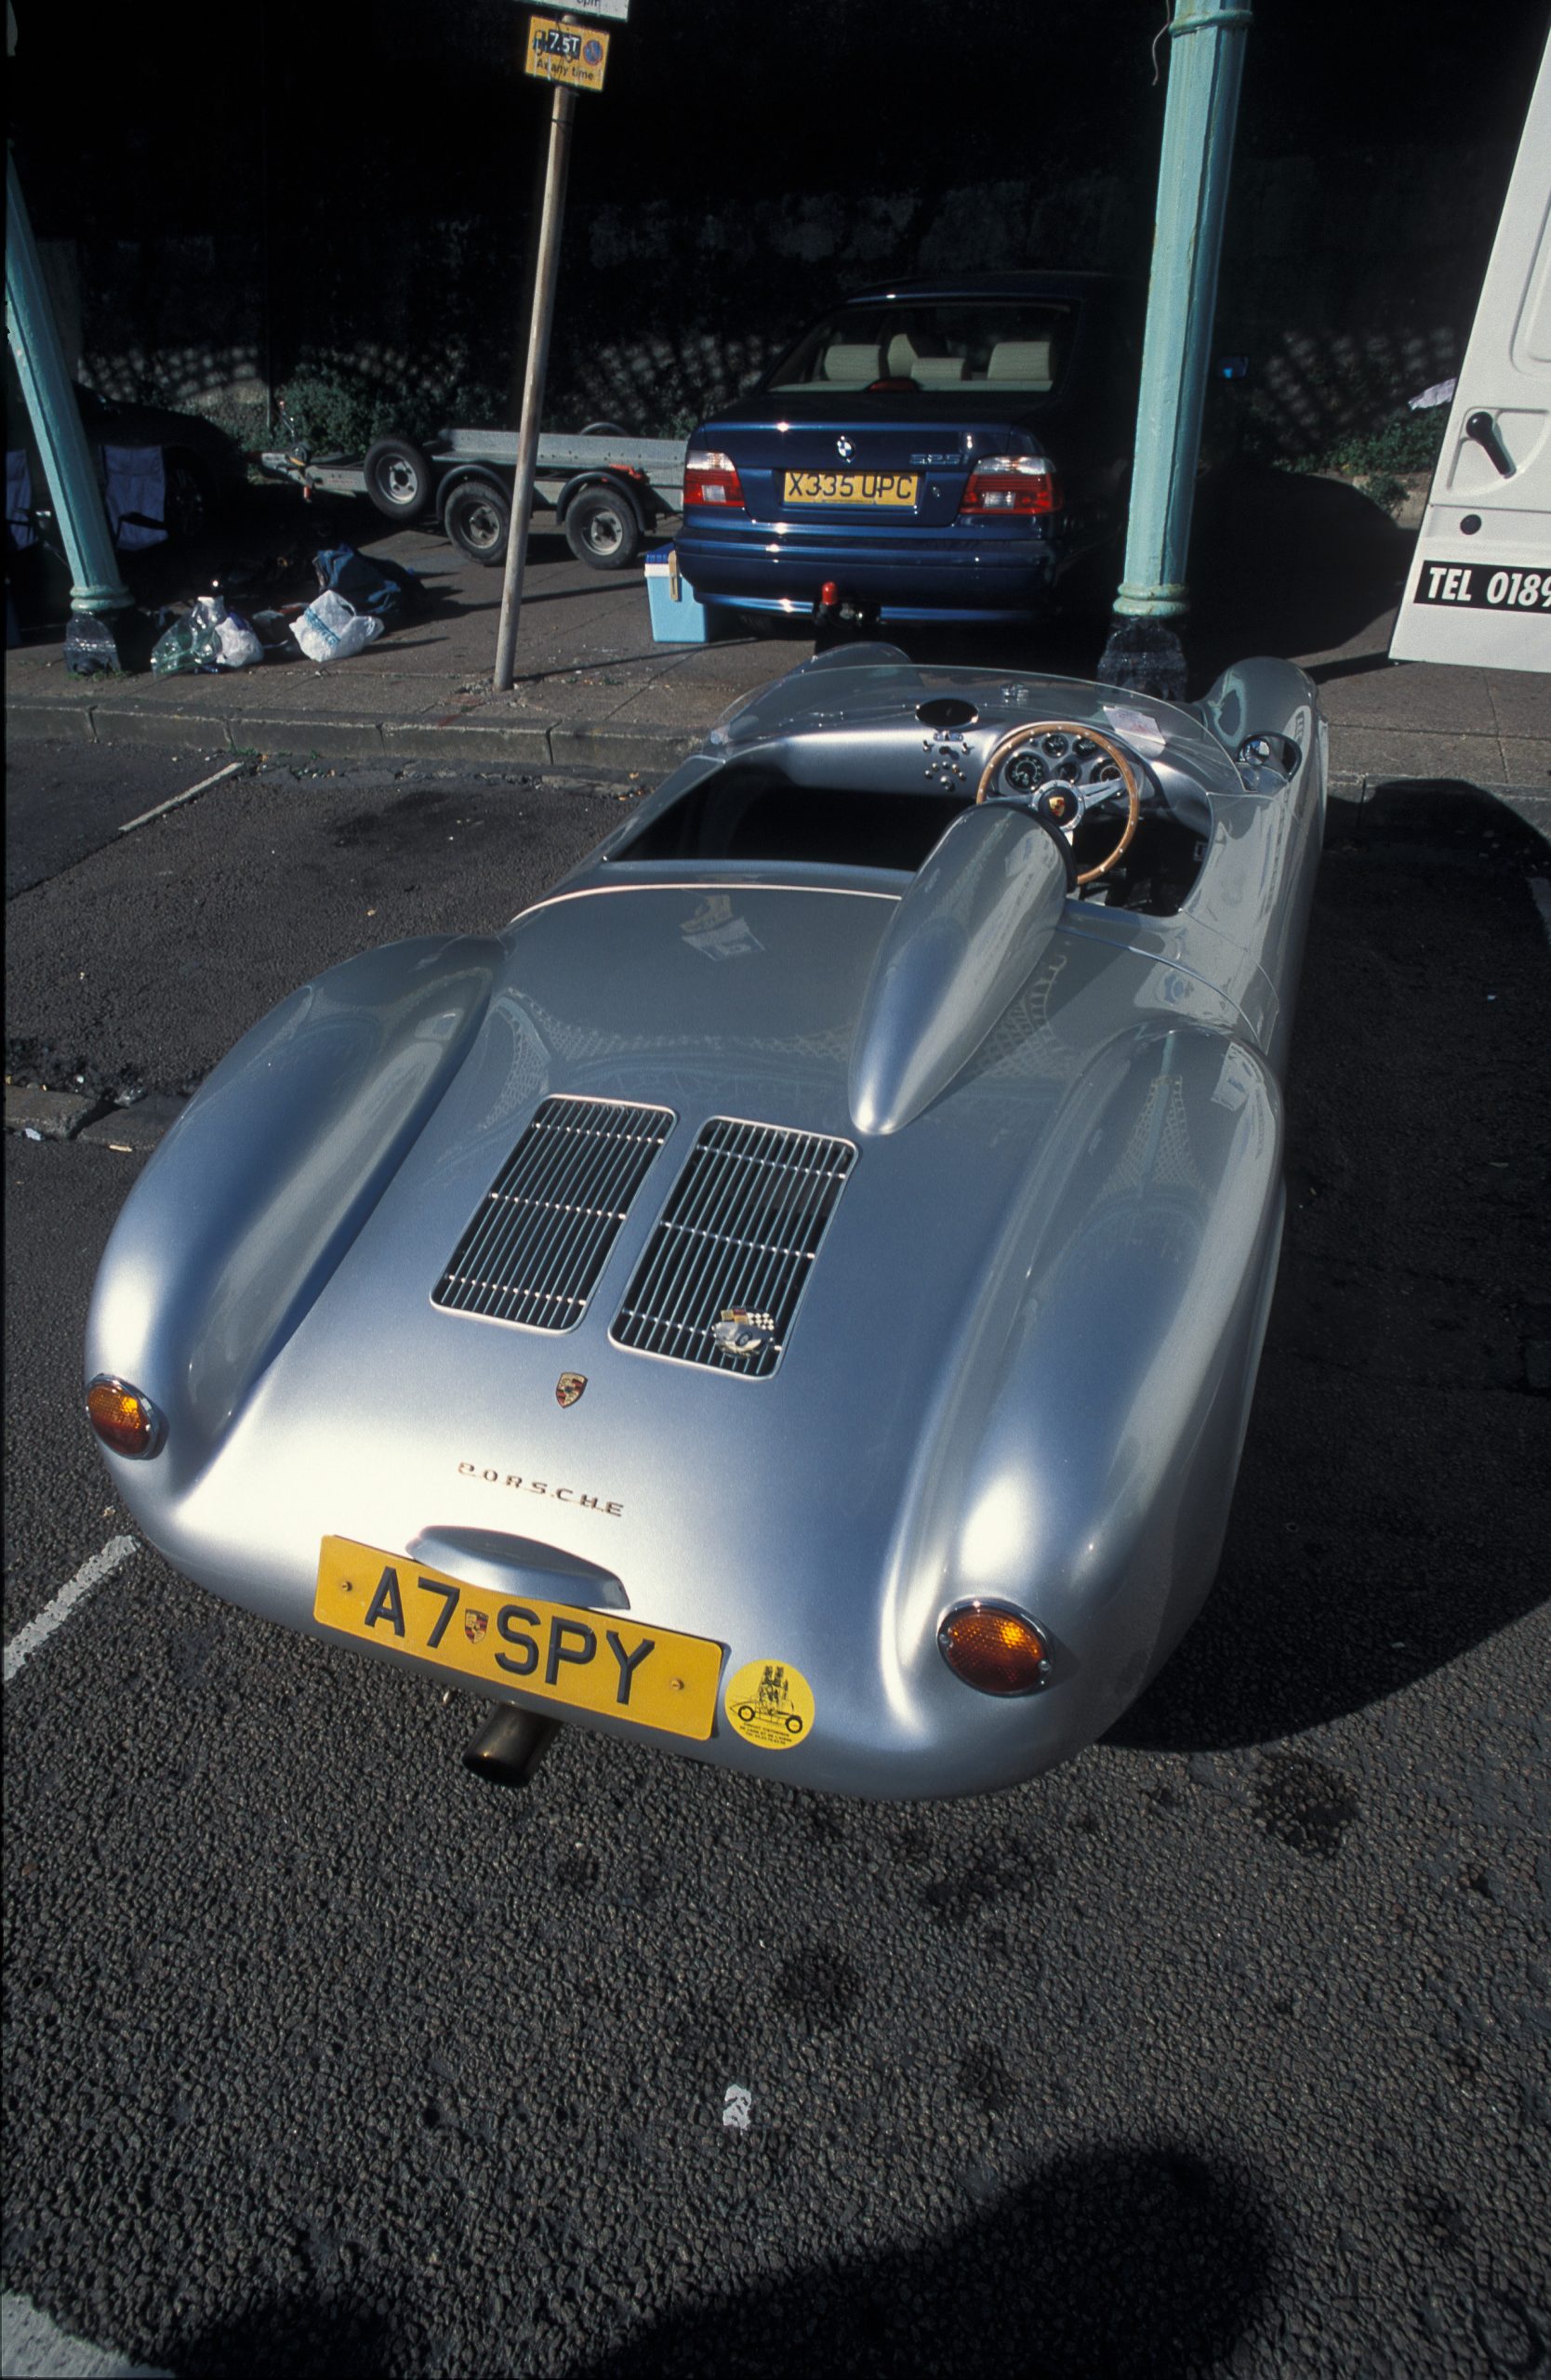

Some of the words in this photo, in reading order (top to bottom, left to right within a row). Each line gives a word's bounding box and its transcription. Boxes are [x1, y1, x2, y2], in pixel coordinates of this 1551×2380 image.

[550, 31, 580, 55] 7.5T
[789, 469, 855, 497] X335
[861, 470, 913, 499] UPC
[1427, 566, 1472, 602] TEL
[457, 1461, 625, 1518] PORSCHE
[365, 1566, 460, 1649] A7
[494, 1604, 656, 1705] SPY
